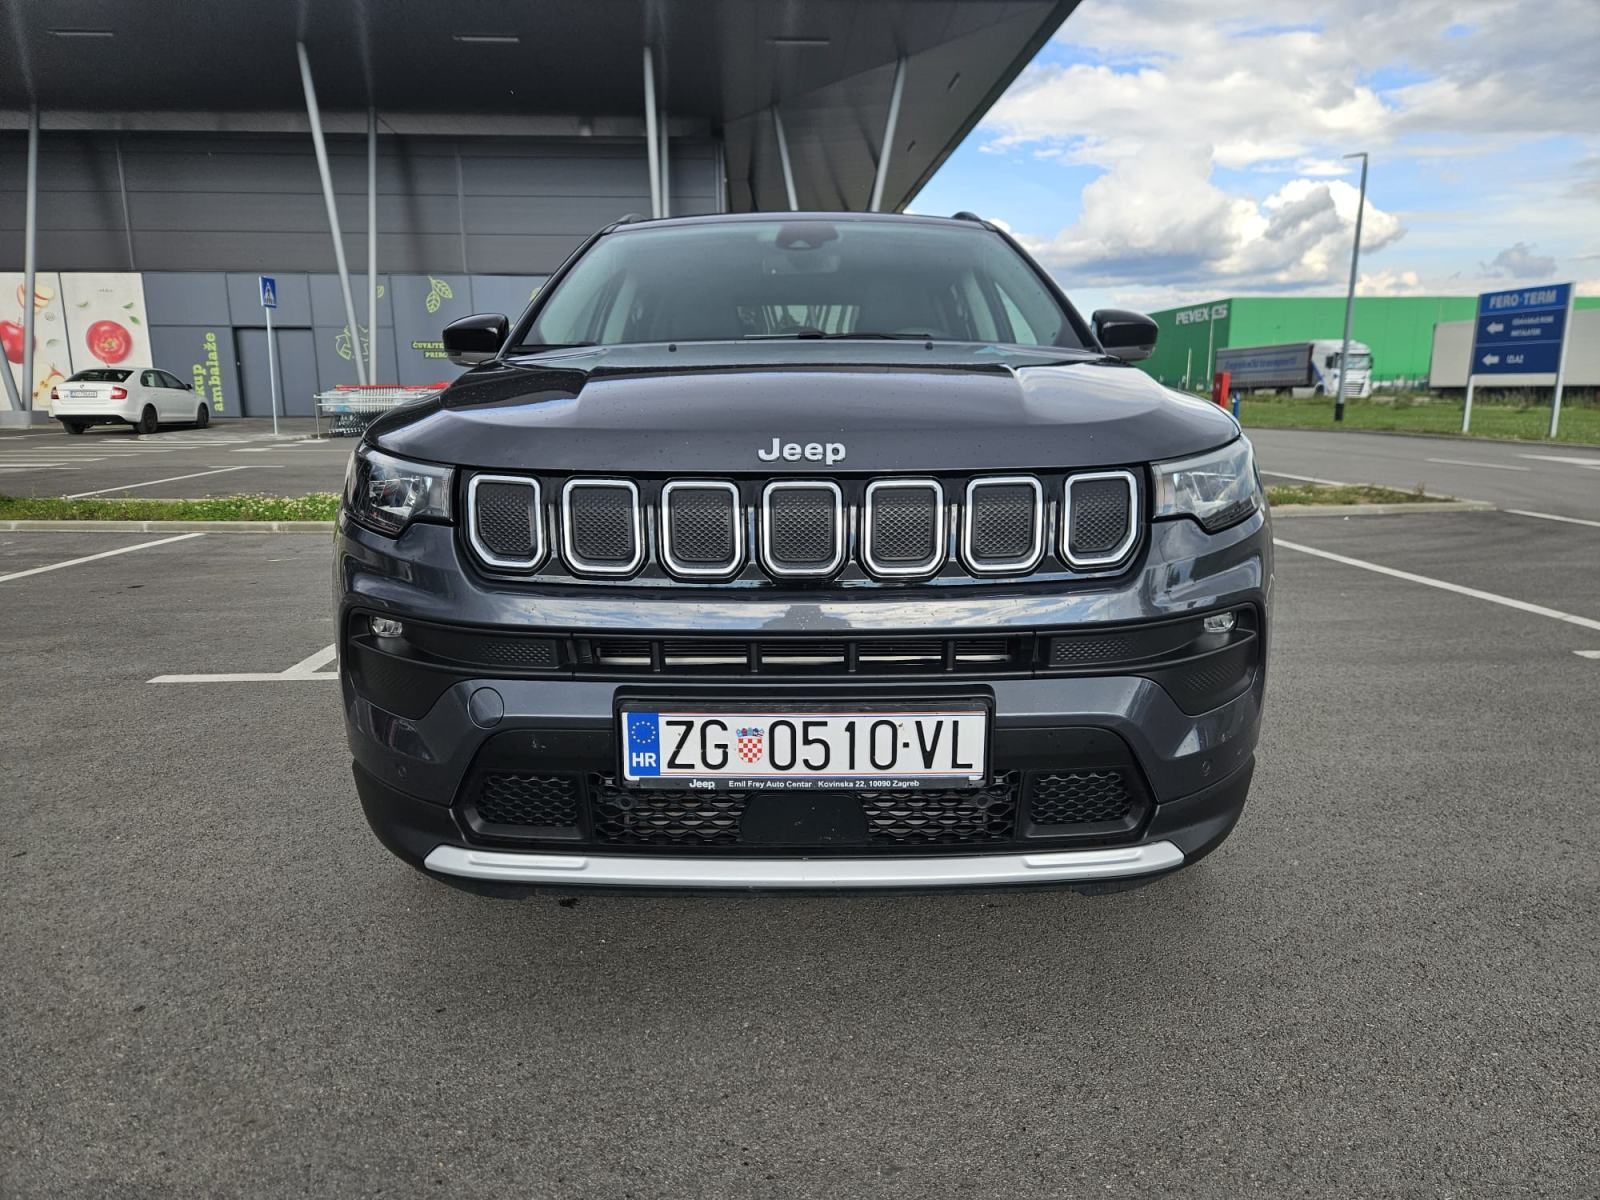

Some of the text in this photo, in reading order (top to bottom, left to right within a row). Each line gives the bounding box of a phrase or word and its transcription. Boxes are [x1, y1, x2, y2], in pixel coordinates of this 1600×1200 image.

[193, 363, 207, 396] kup
[202, 331, 225, 412] ambalaže
[758, 437, 846, 465] Jeep
[632, 753, 657, 768] HR
[665, 719, 729, 770] ZG
[689, 779, 716, 790] Jeep
[728, 780, 746, 788] Emil
[747, 780, 765, 789] Frey
[766, 780, 784, 788] Auto
[786, 780, 812, 788] Centar
[818, 780, 854, 788] Kovinska
[869, 780, 891, 788] 10090
[892, 780, 920, 788] Zagreb
